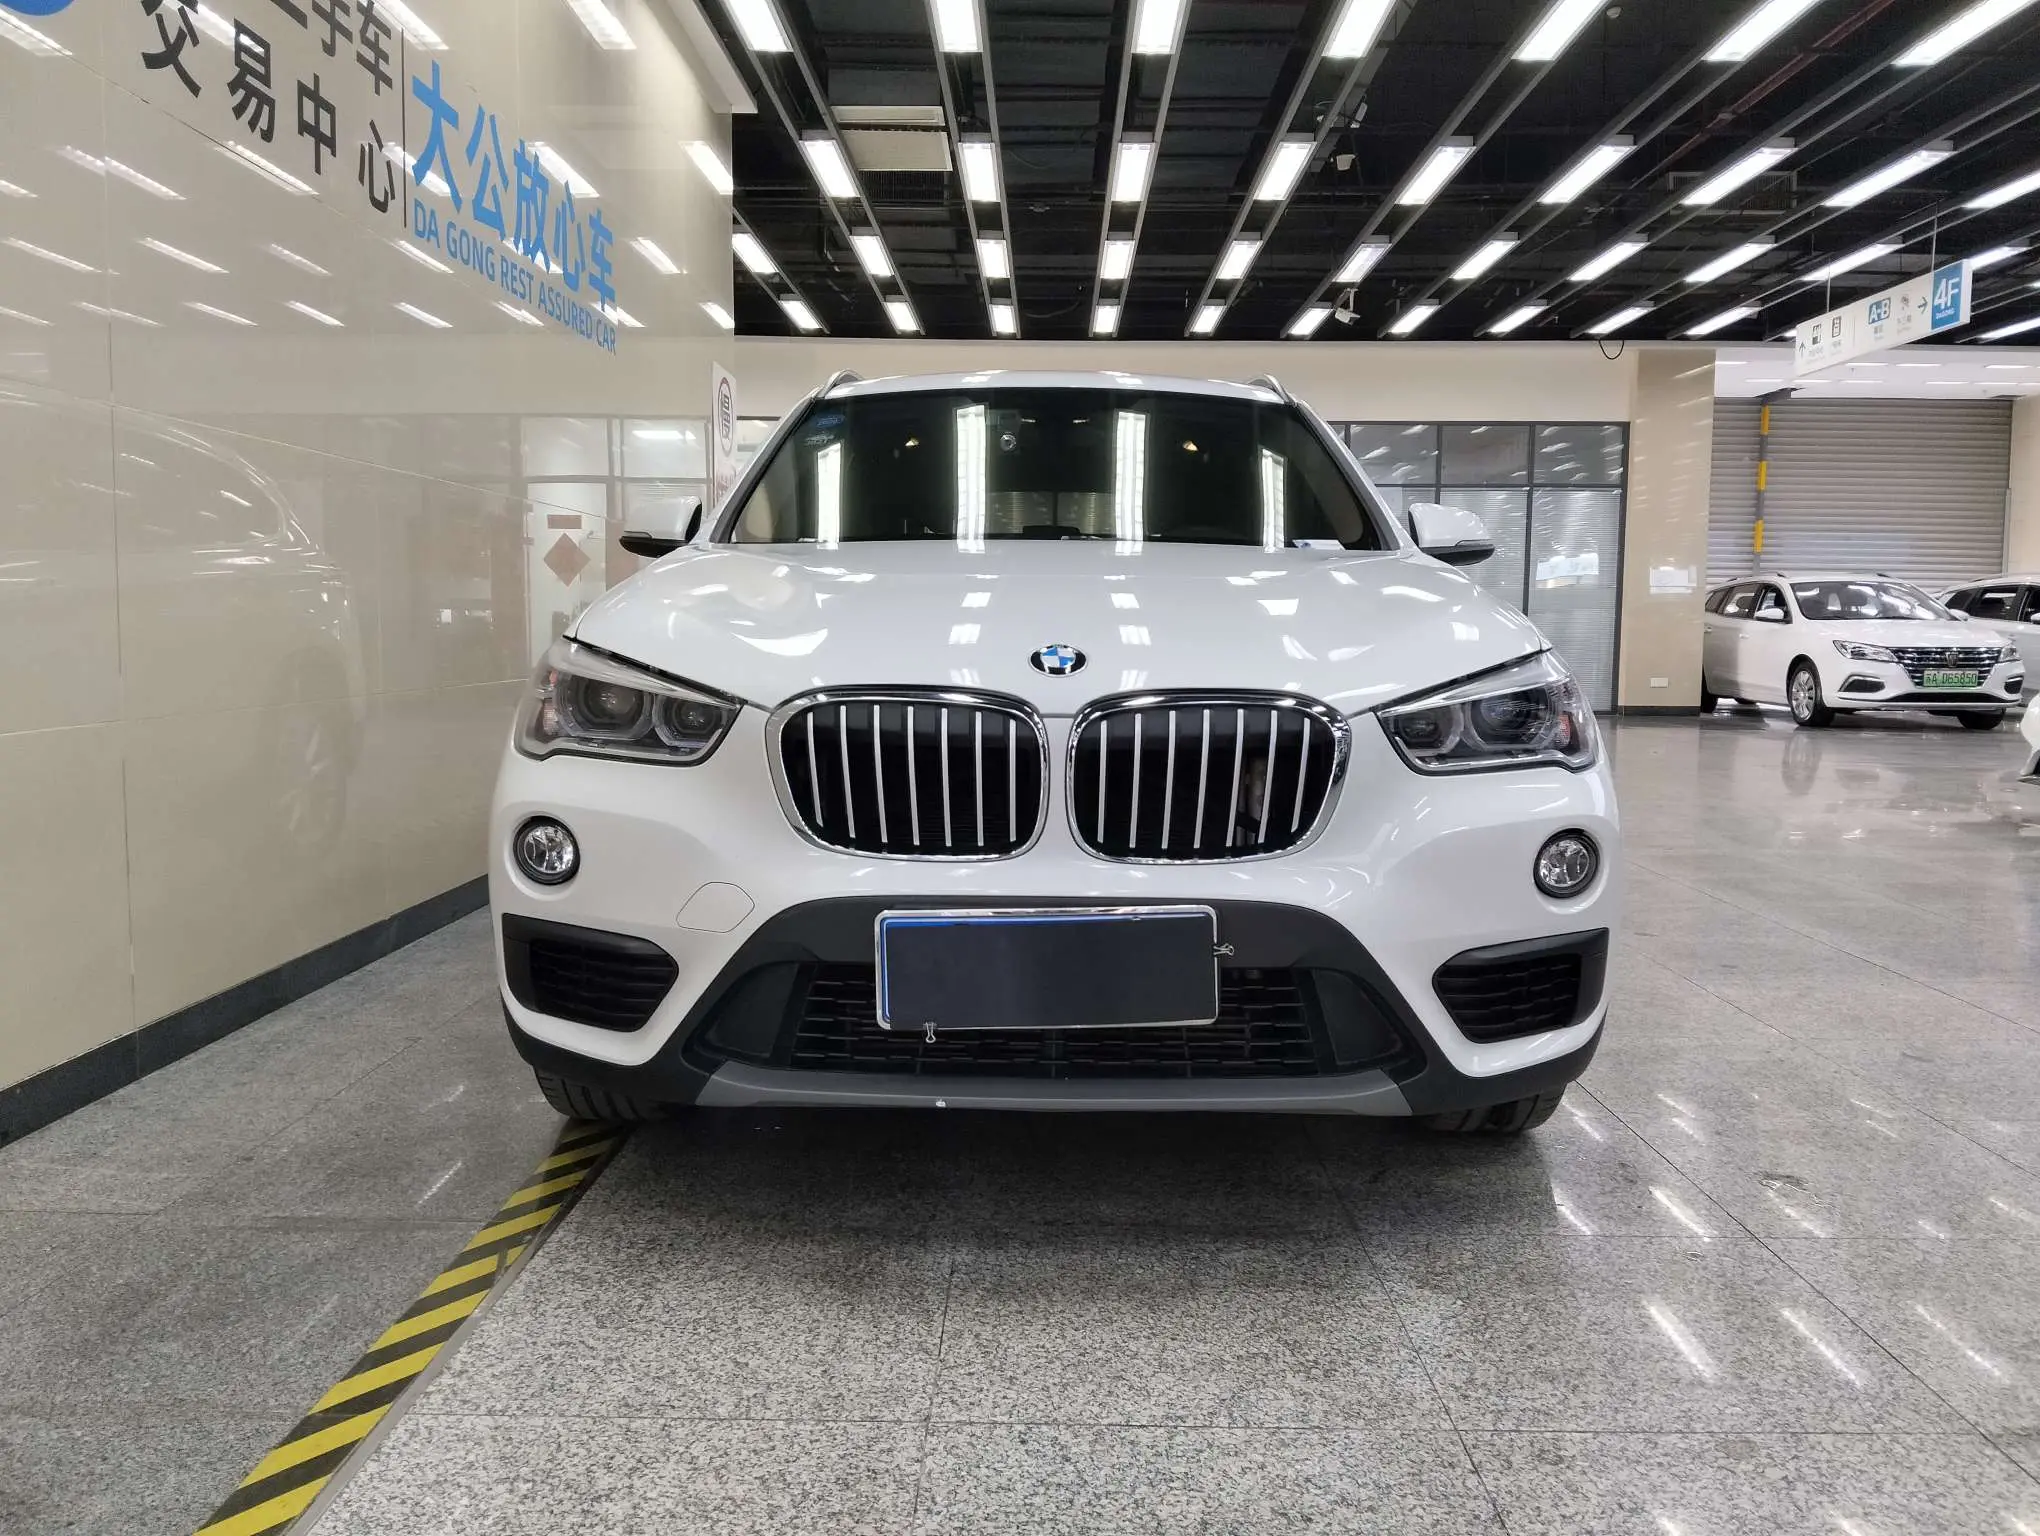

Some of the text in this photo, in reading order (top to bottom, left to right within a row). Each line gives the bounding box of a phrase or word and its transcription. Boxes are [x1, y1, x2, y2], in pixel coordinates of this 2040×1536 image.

[141, 0, 396, 214] 交易中心
[411, 59, 618, 312] 大公放心车
[413, 197, 616, 355] DA GONG REST ASSURED CAR
[1934, 277, 1960, 310] 4F
